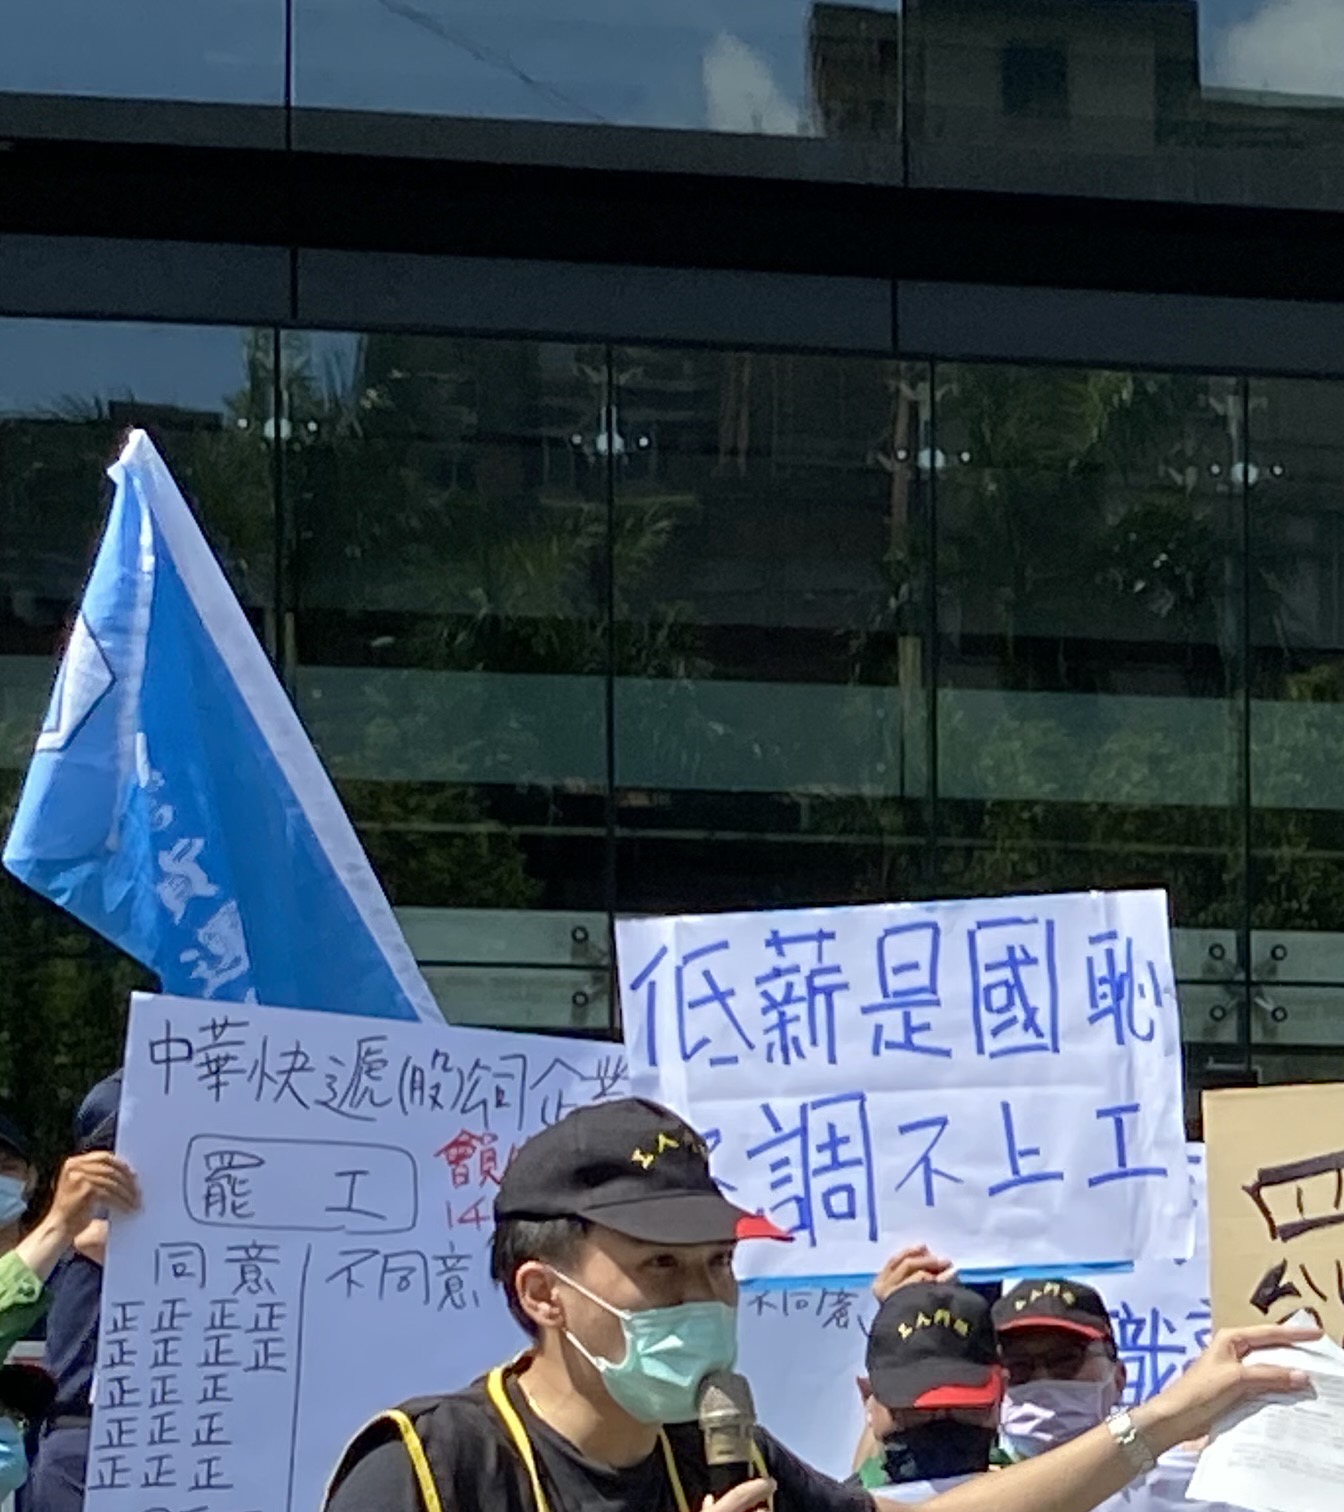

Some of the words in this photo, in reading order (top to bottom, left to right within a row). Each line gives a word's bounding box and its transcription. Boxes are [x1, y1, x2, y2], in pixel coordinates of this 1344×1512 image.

[630, 919, 1163, 1066] 低薪是國恥
[700, 1091, 1168, 1246] 調不上工
[154, 1240, 281, 1295] 同意
[325, 1247, 479, 1311] 不同意
